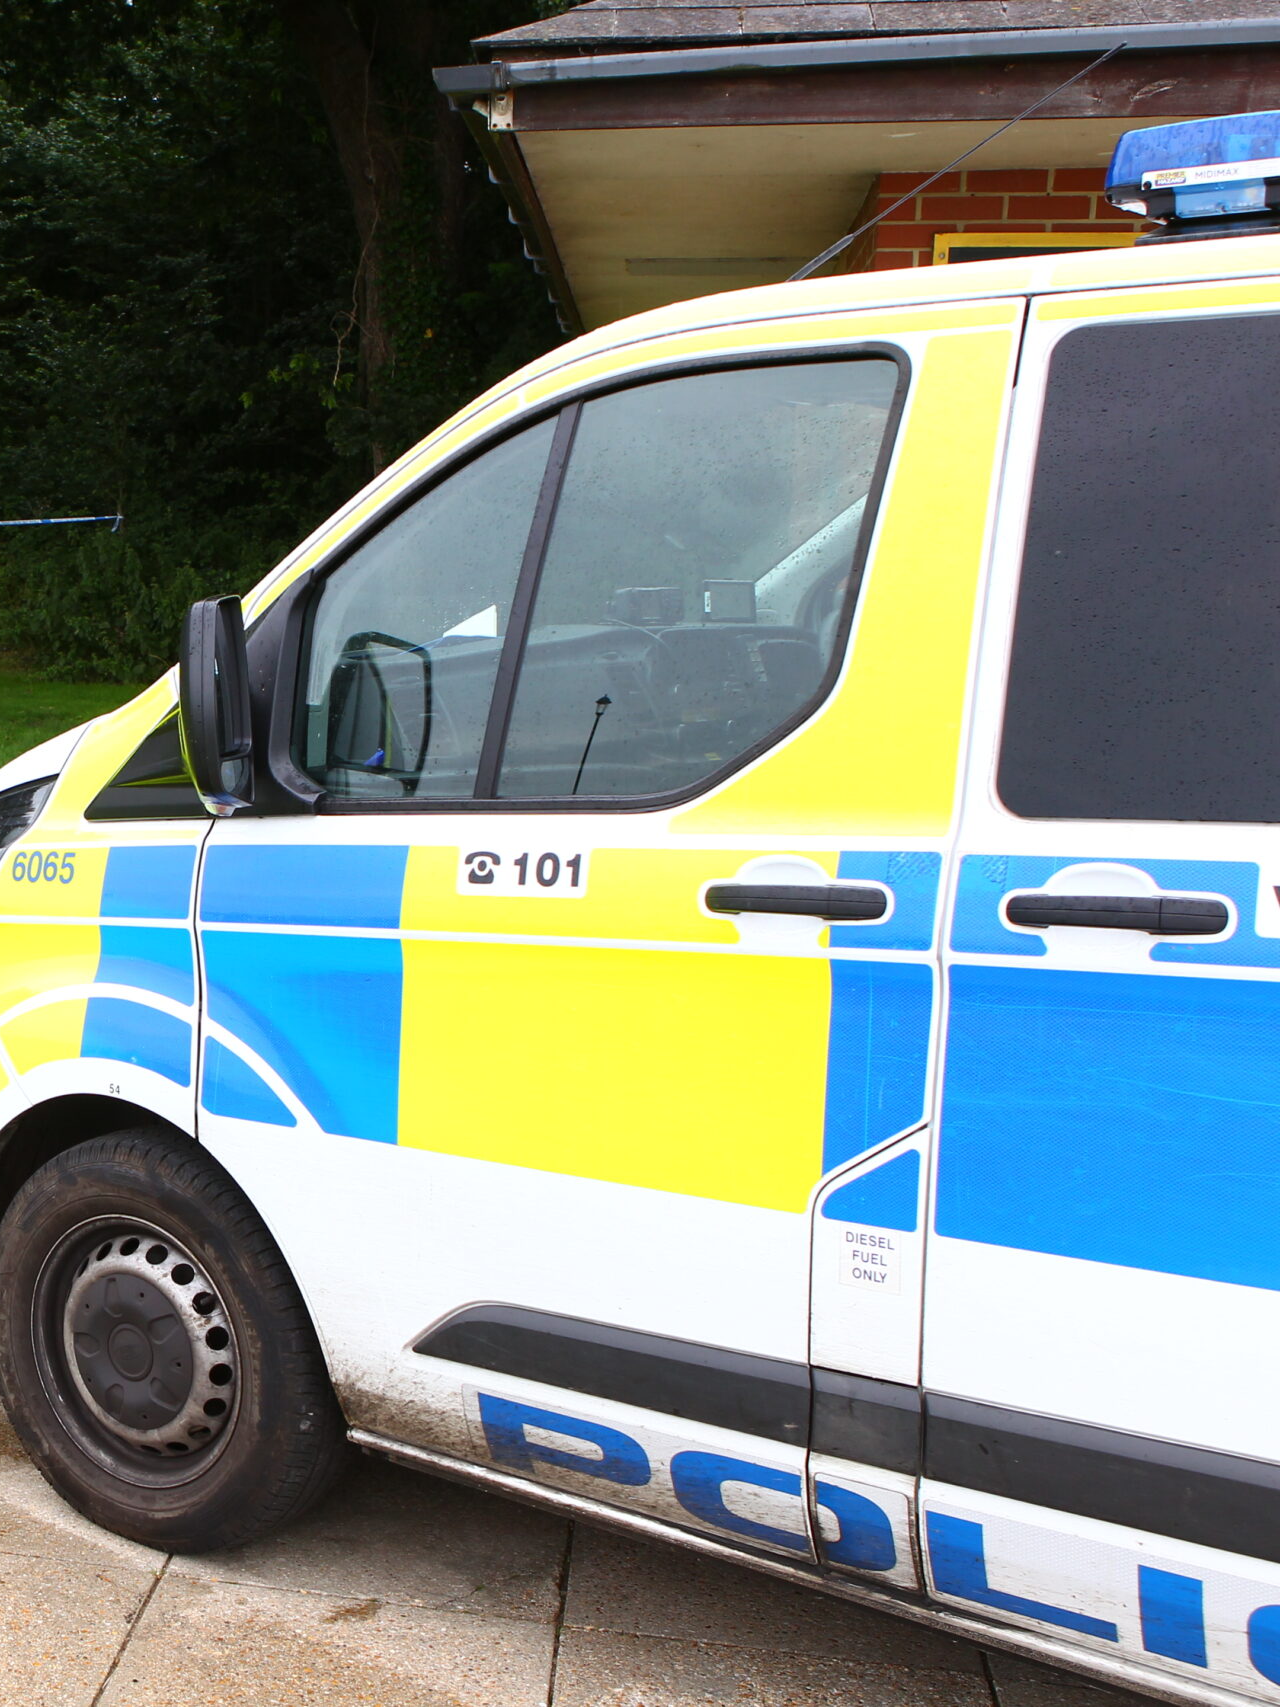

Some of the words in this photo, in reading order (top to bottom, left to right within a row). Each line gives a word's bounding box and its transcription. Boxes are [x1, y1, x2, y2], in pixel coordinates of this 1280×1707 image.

[1195, 168, 1239, 179] MIDIMAX
[13, 851, 76, 884] 6065
[514, 852, 582, 887] 101
[109, 1083, 120, 1095] 54
[846, 1231, 895, 1250] DIESEL
[853, 1250, 887, 1267] FUEL
[852, 1267, 887, 1283] ONLY
[478, 1393, 1280, 1687] POLI
